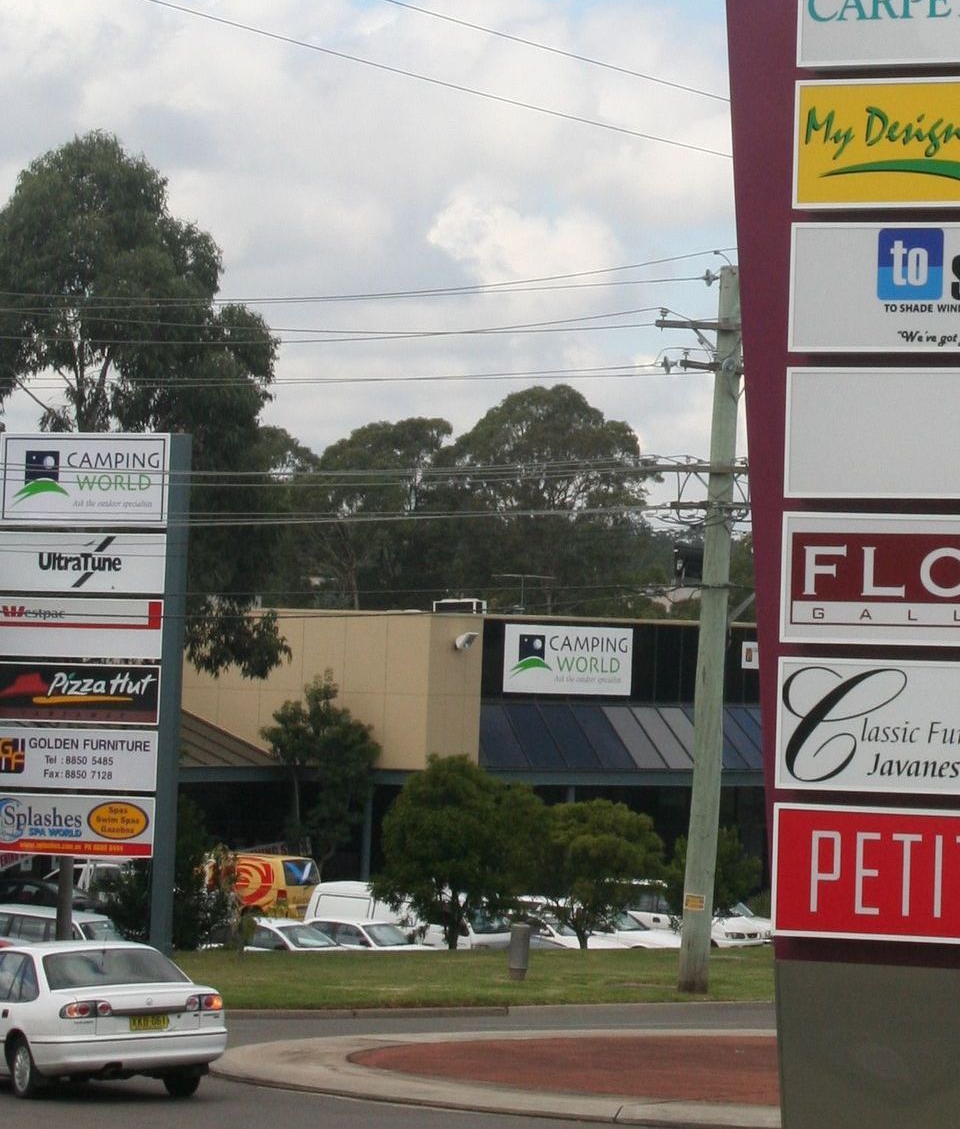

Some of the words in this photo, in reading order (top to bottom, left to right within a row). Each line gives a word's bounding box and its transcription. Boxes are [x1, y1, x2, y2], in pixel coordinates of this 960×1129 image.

[804, 106, 855, 160] My
[890, 239, 929, 286] to
[884, 303, 897, 313] TO
[899, 303, 933, 313] SHADE
[938, 333, 958, 347] got
[67, 452, 160, 469] CAMPING
[76, 473, 151, 491] WORLD
[38, 551, 122, 571] UltraTune
[1, 605, 65, 620] Westpac
[549, 635, 628, 653] CAMPING
[556, 656, 620, 673] WORLD
[47, 672, 106, 696] Pizza
[109, 672, 157, 696] Hut
[29, 737, 79, 750] GOLDEN
[83, 739, 151, 752] FURNITURE
[91, 756, 114, 766] 5485
[91, 770, 113, 780] 7128
[4, 805, 82, 830] Splashes
